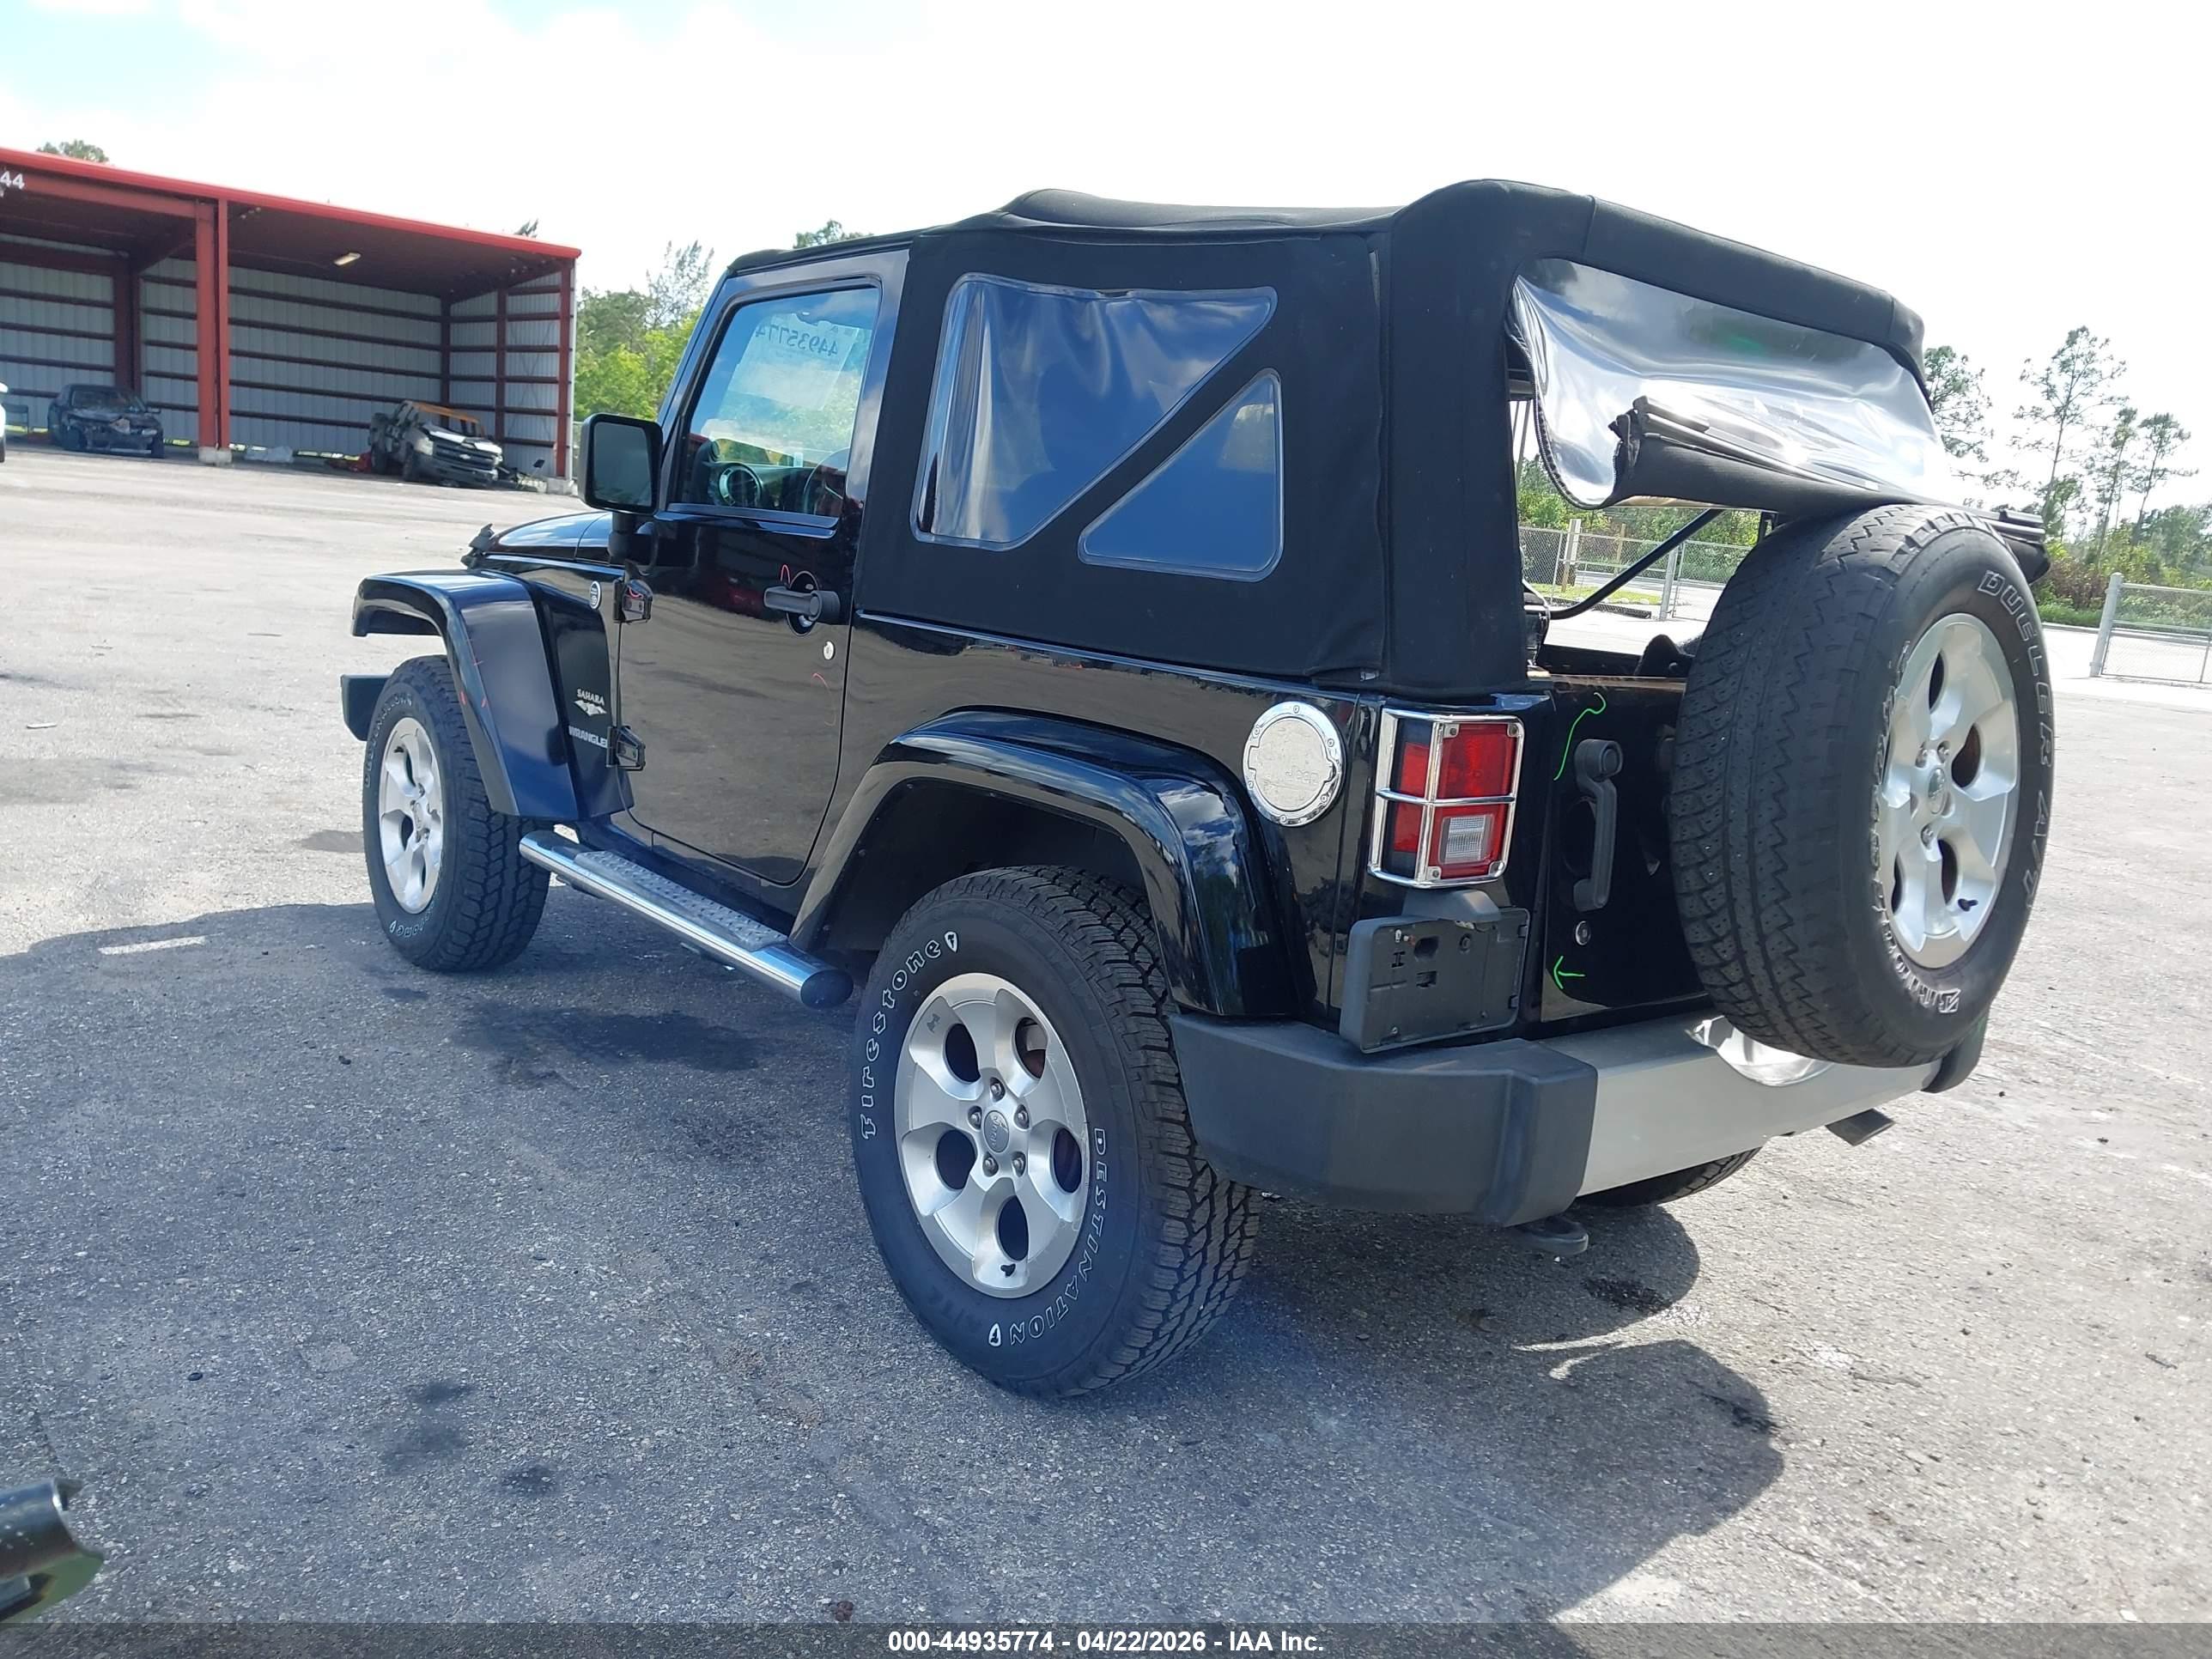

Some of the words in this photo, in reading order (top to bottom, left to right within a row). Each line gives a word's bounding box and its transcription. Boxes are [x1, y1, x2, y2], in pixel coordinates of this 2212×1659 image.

[576, 689, 605, 707] SAHARA
[1978, 570, 2054, 768] DUELER
[568, 725, 608, 749] WRANGLE
[1285, 765, 1319, 785] Jeep
[860, 939, 941, 1139] Firestone
[1010, 1127, 1108, 1346] DESTINATION
